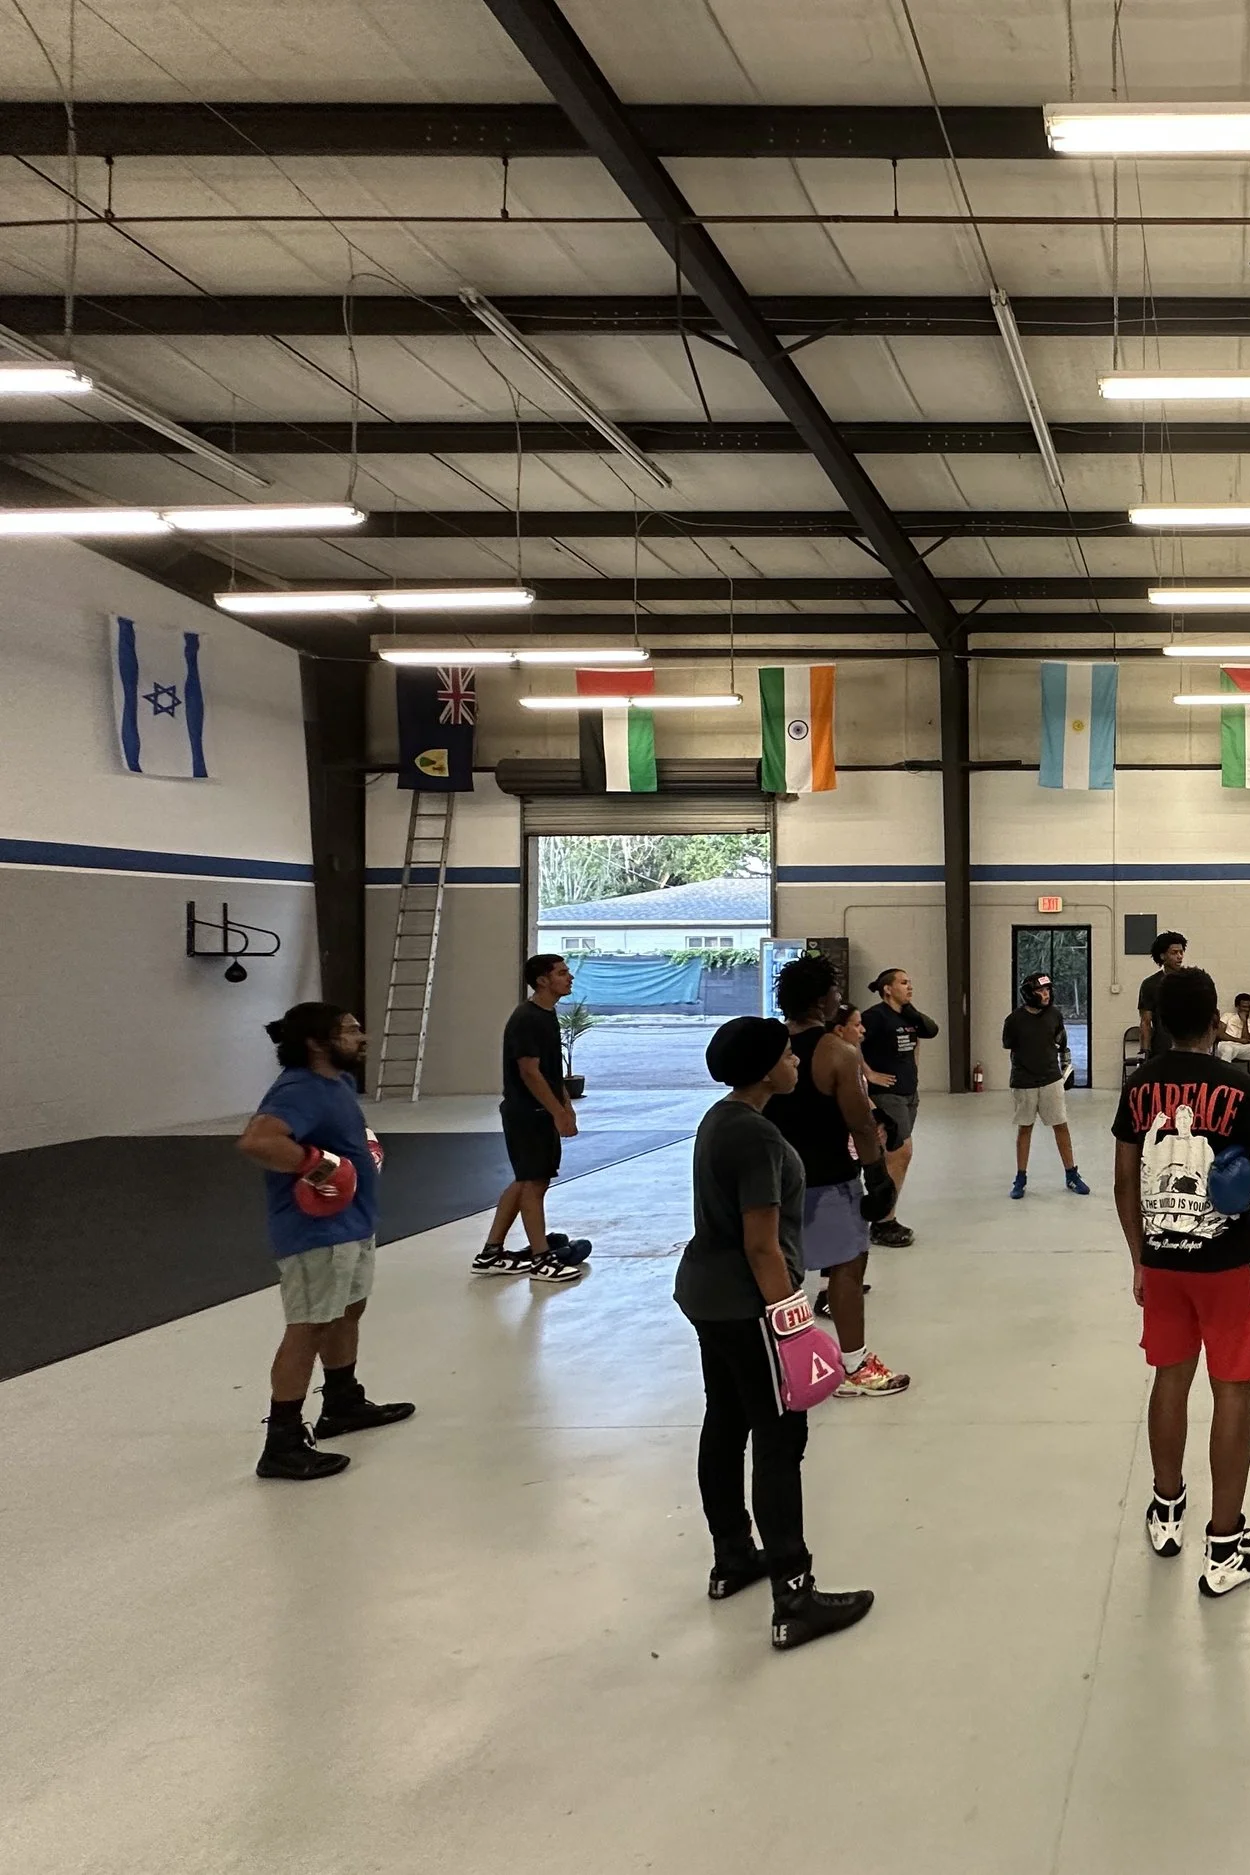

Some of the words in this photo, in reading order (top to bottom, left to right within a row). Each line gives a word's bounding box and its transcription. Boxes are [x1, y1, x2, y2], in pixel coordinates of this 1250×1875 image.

[1042, 897, 1059, 911] EXIT
[1128, 1082, 1245, 1137] SCARFACE
[1145, 1199, 1157, 1209] THE
[1178, 1198, 1186, 1209] IS
